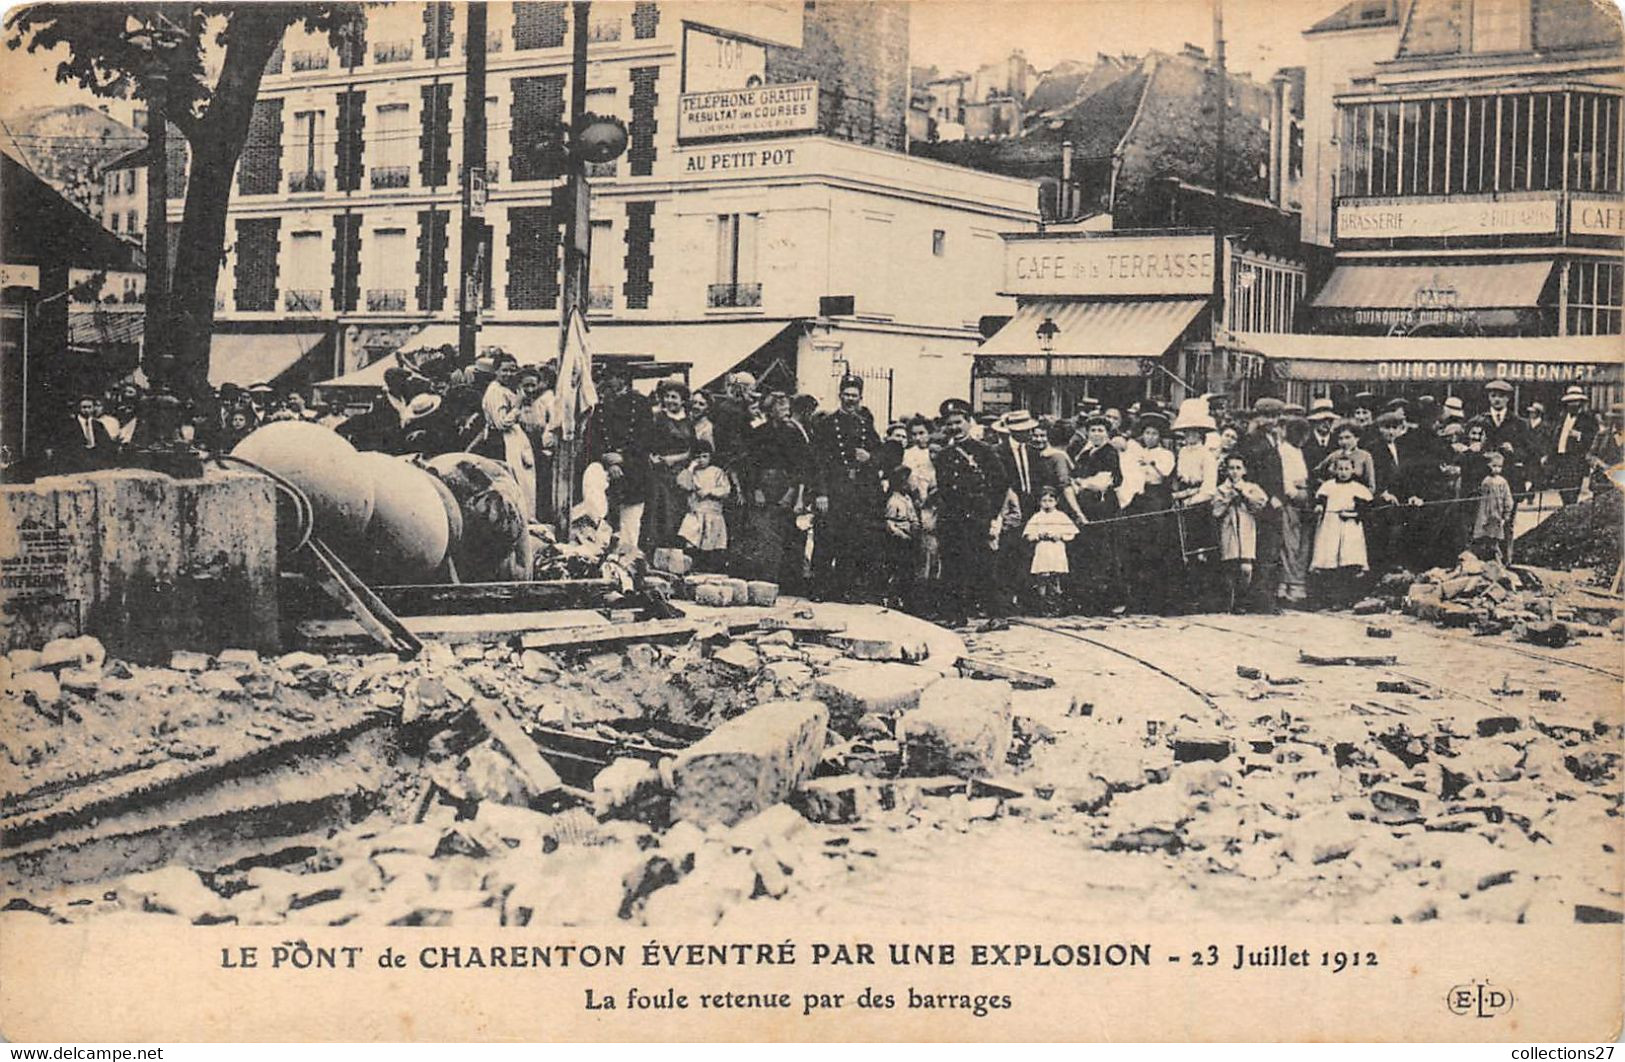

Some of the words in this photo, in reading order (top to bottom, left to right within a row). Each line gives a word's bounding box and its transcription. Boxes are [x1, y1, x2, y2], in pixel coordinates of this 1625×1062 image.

[760, 86, 814, 105] GRATUIT
[688, 110, 738, 123] RESULTAT
[754, 103, 808, 119] COURSES
[687, 156, 707, 171] AU
[711, 152, 757, 170] PETIT
[761, 148, 795, 166] POT
[1340, 212, 1403, 231] BRASSERIE
[1016, 255, 1066, 279] CAFE
[1106, 253, 1212, 279] TERRASSE
[1378, 362, 1486, 378] QUINQUINA
[1496, 363, 1597, 380] DUBONNET
